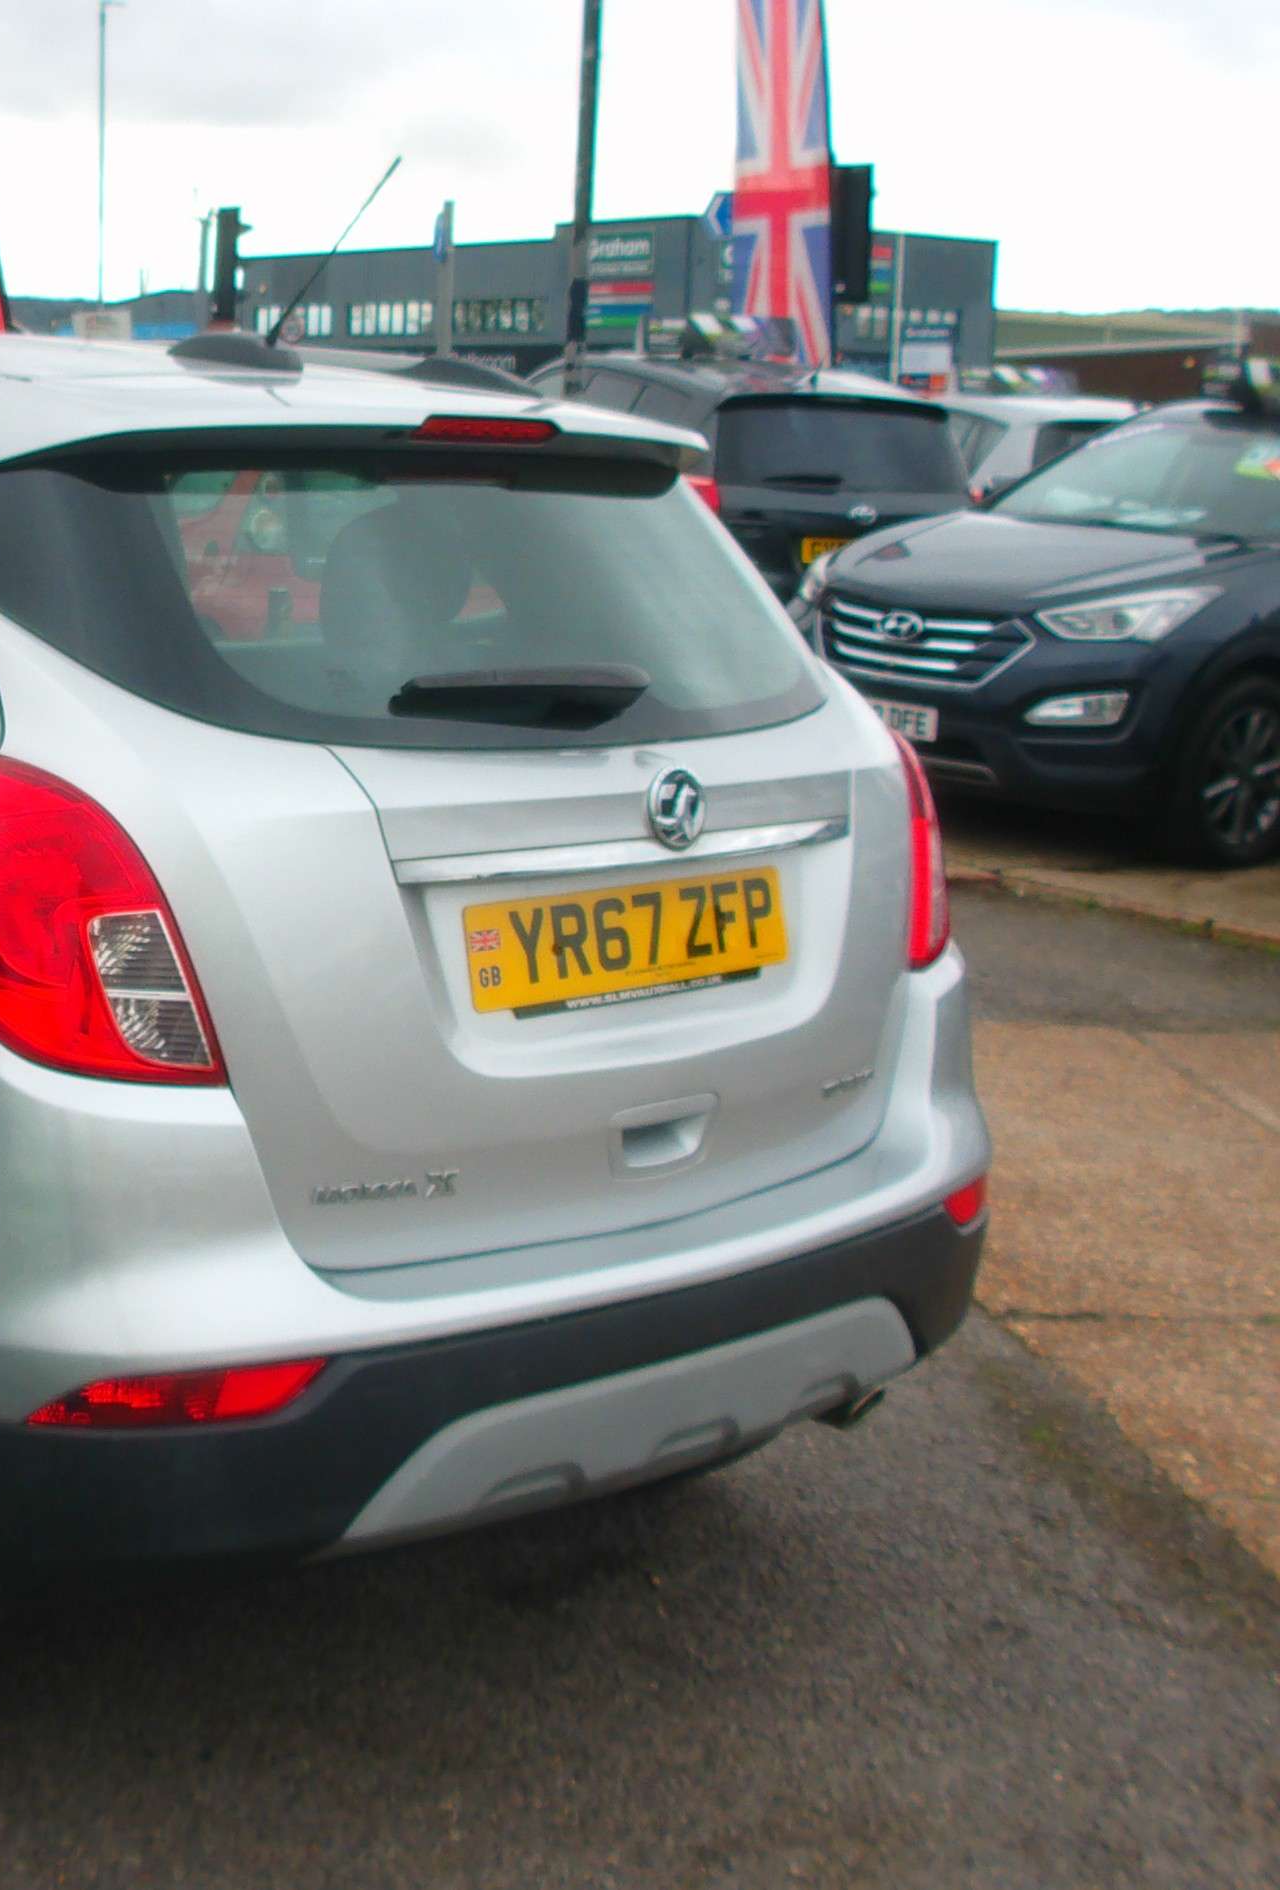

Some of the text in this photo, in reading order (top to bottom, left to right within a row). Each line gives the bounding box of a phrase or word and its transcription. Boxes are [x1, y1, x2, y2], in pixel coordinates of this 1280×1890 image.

[509, 877, 772, 984] YR67 ZFP
[479, 965, 502, 988] GB
